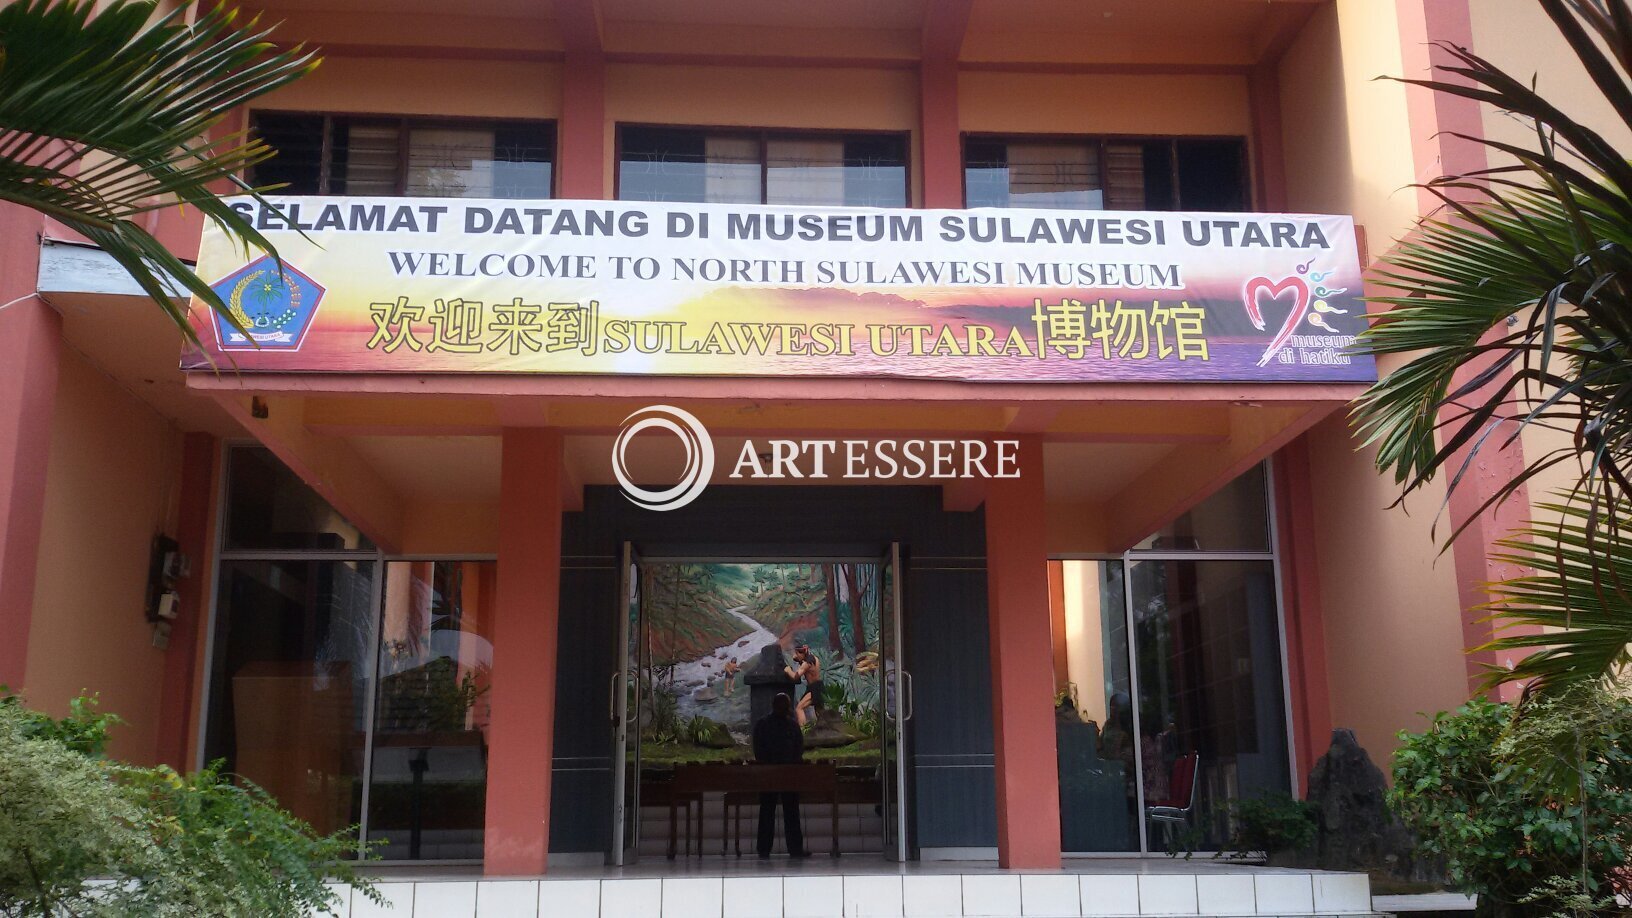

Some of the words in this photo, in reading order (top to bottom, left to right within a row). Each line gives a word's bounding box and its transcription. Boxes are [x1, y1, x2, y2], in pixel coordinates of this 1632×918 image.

[229, 202, 448, 233] SELAMAT
[464, 207, 649, 236] DATANG
[667, 211, 708, 239] DI
[728, 213, 923, 242] MUSEUM
[940, 216, 1165, 246] SULAWESI
[1182, 220, 1331, 249] UTARA
[388, 251, 597, 279] WELCOME
[608, 256, 660, 281] TO
[672, 257, 804, 284] NORTH
[817, 260, 1005, 286] SULAWESI
[1016, 261, 1182, 288] MUSEUM
[1279, 347, 1295, 364] di
